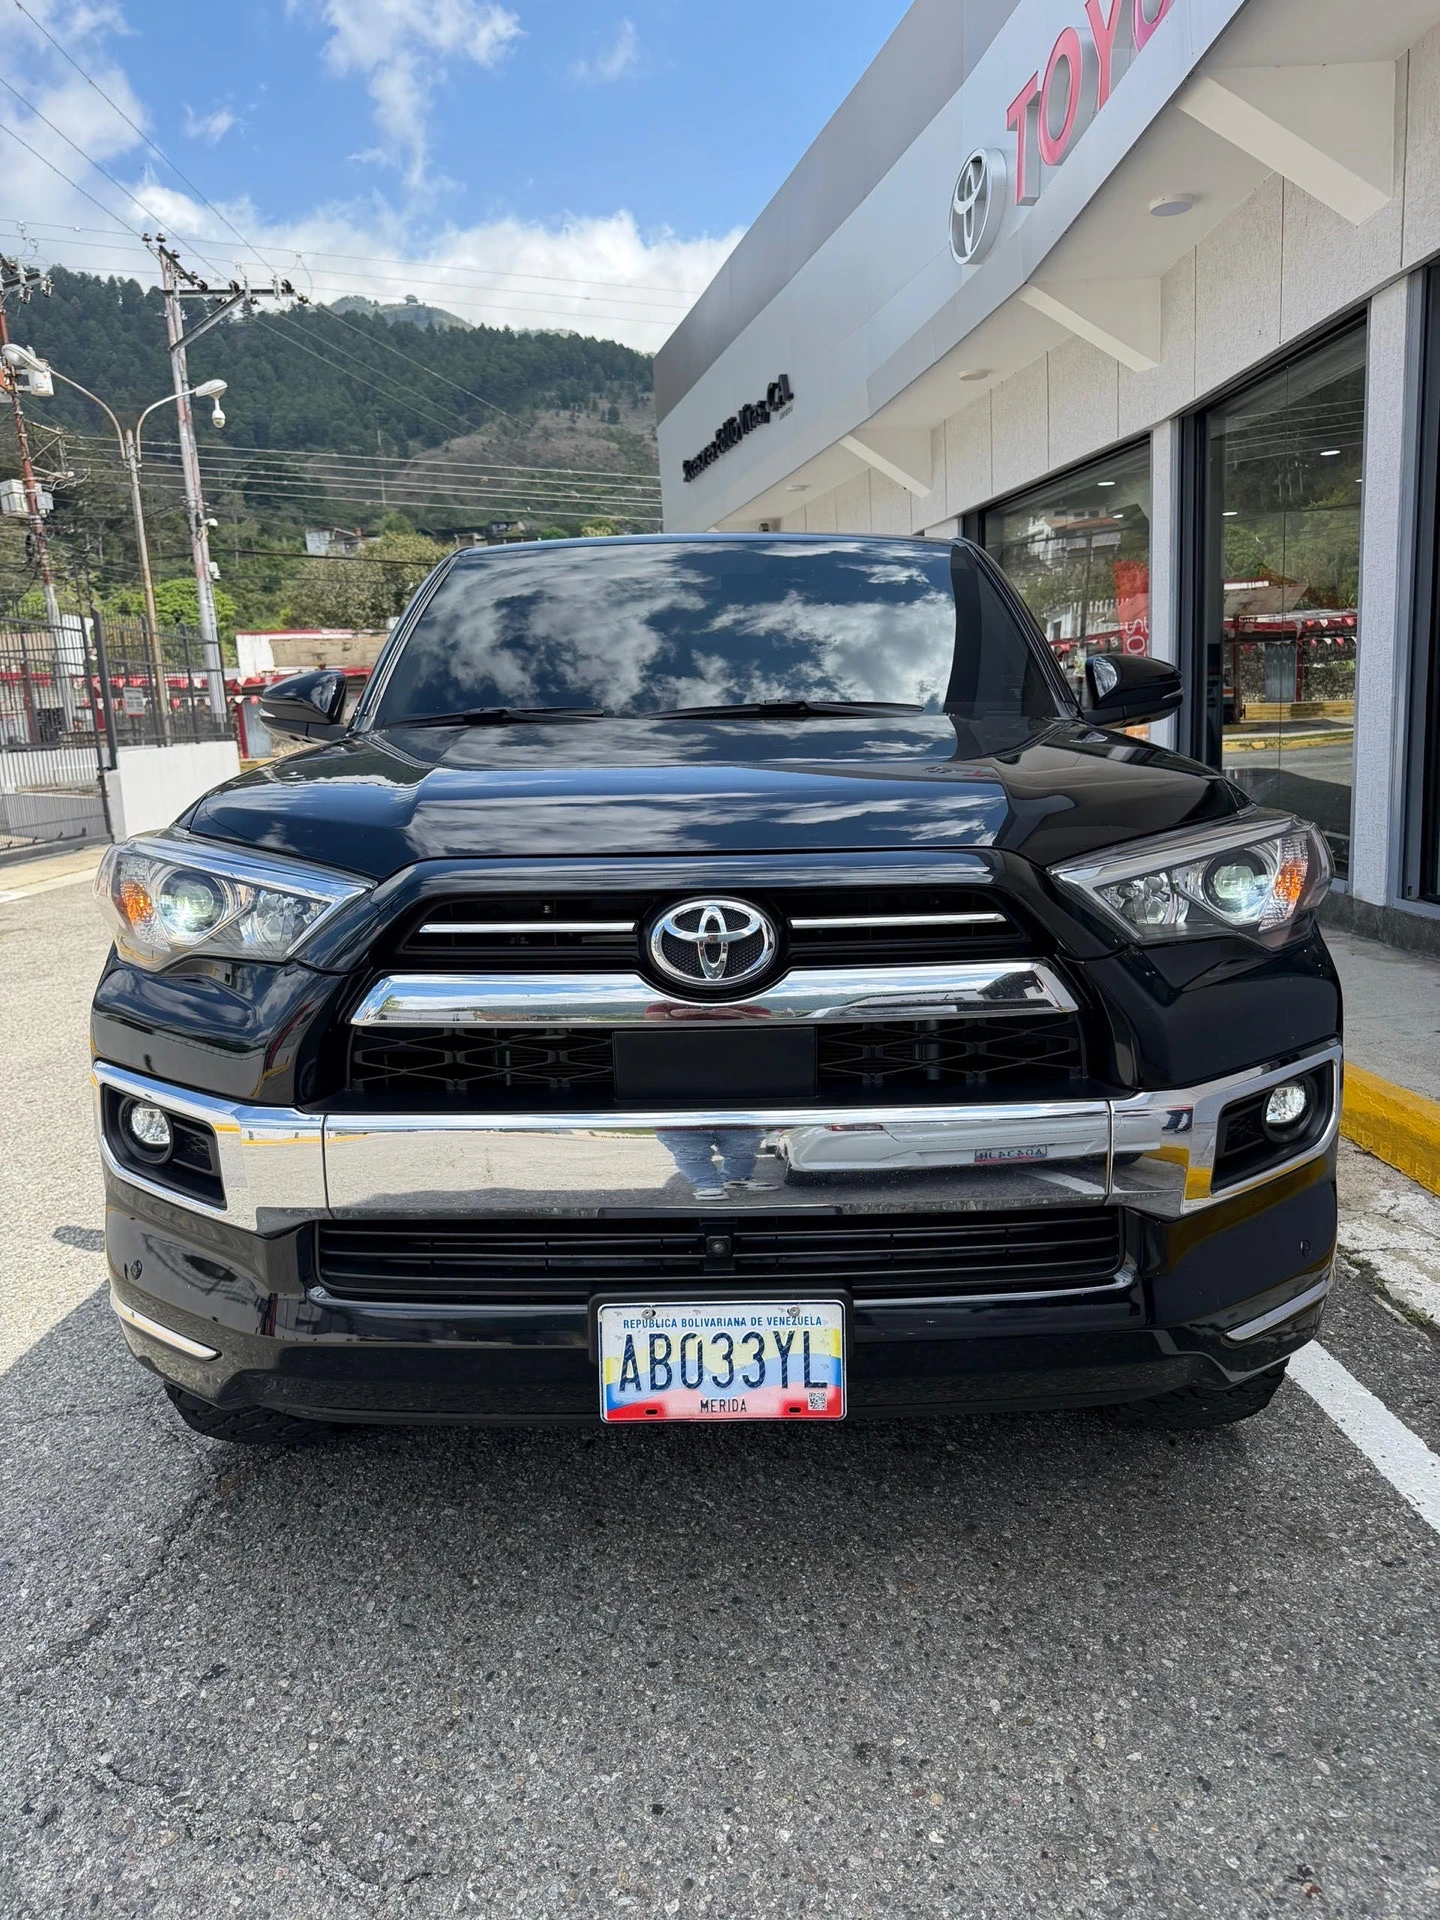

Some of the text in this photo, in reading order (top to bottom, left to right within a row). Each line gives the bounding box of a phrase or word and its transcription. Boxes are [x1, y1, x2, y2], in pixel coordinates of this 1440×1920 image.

[681, 1317, 746, 1328] BOLIVARIANA
[750, 1317, 763, 1326] DE
[766, 1316, 822, 1326] VENEZUELA
[619, 1330, 828, 1392] AB033YL
[700, 1398, 747, 1413] MERIDA
